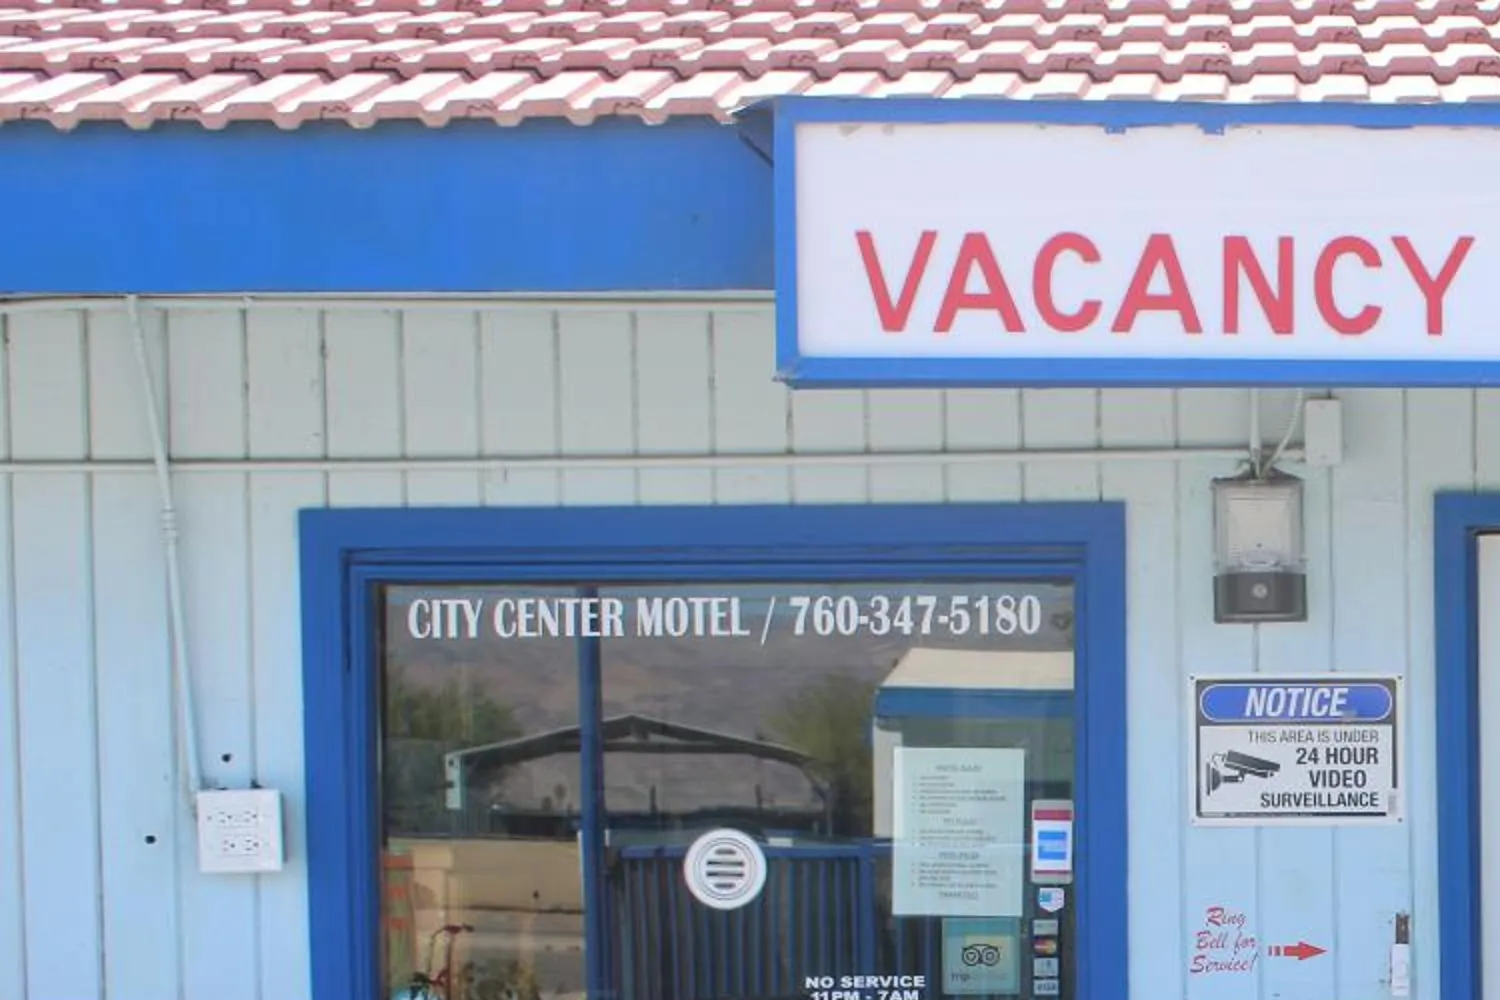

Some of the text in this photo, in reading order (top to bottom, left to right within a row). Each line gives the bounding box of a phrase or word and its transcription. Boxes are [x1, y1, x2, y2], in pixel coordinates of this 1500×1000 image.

[855, 229, 1475, 336] VACANCY
[408, 598, 481, 639] CITY
[494, 597, 624, 638] CENTER
[636, 596, 750, 638] MOTEL
[789, 594, 1042, 637] 760-347-5180
[1244, 687, 1349, 717] NOTICE
[1248, 729, 1379, 743] THIS AREA IS UNDER
[1295, 747, 1379, 765] 24 HOUR
[1309, 770, 1367, 788] VIDEO
[1260, 792, 1379, 808] SURVEILLANCE
[1205, 906, 1247, 928] Ring
[1196, 931, 1257, 954] Bell for
[1190, 952, 1260, 973] Service!
[805, 975, 926, 989] NO SERVICE
